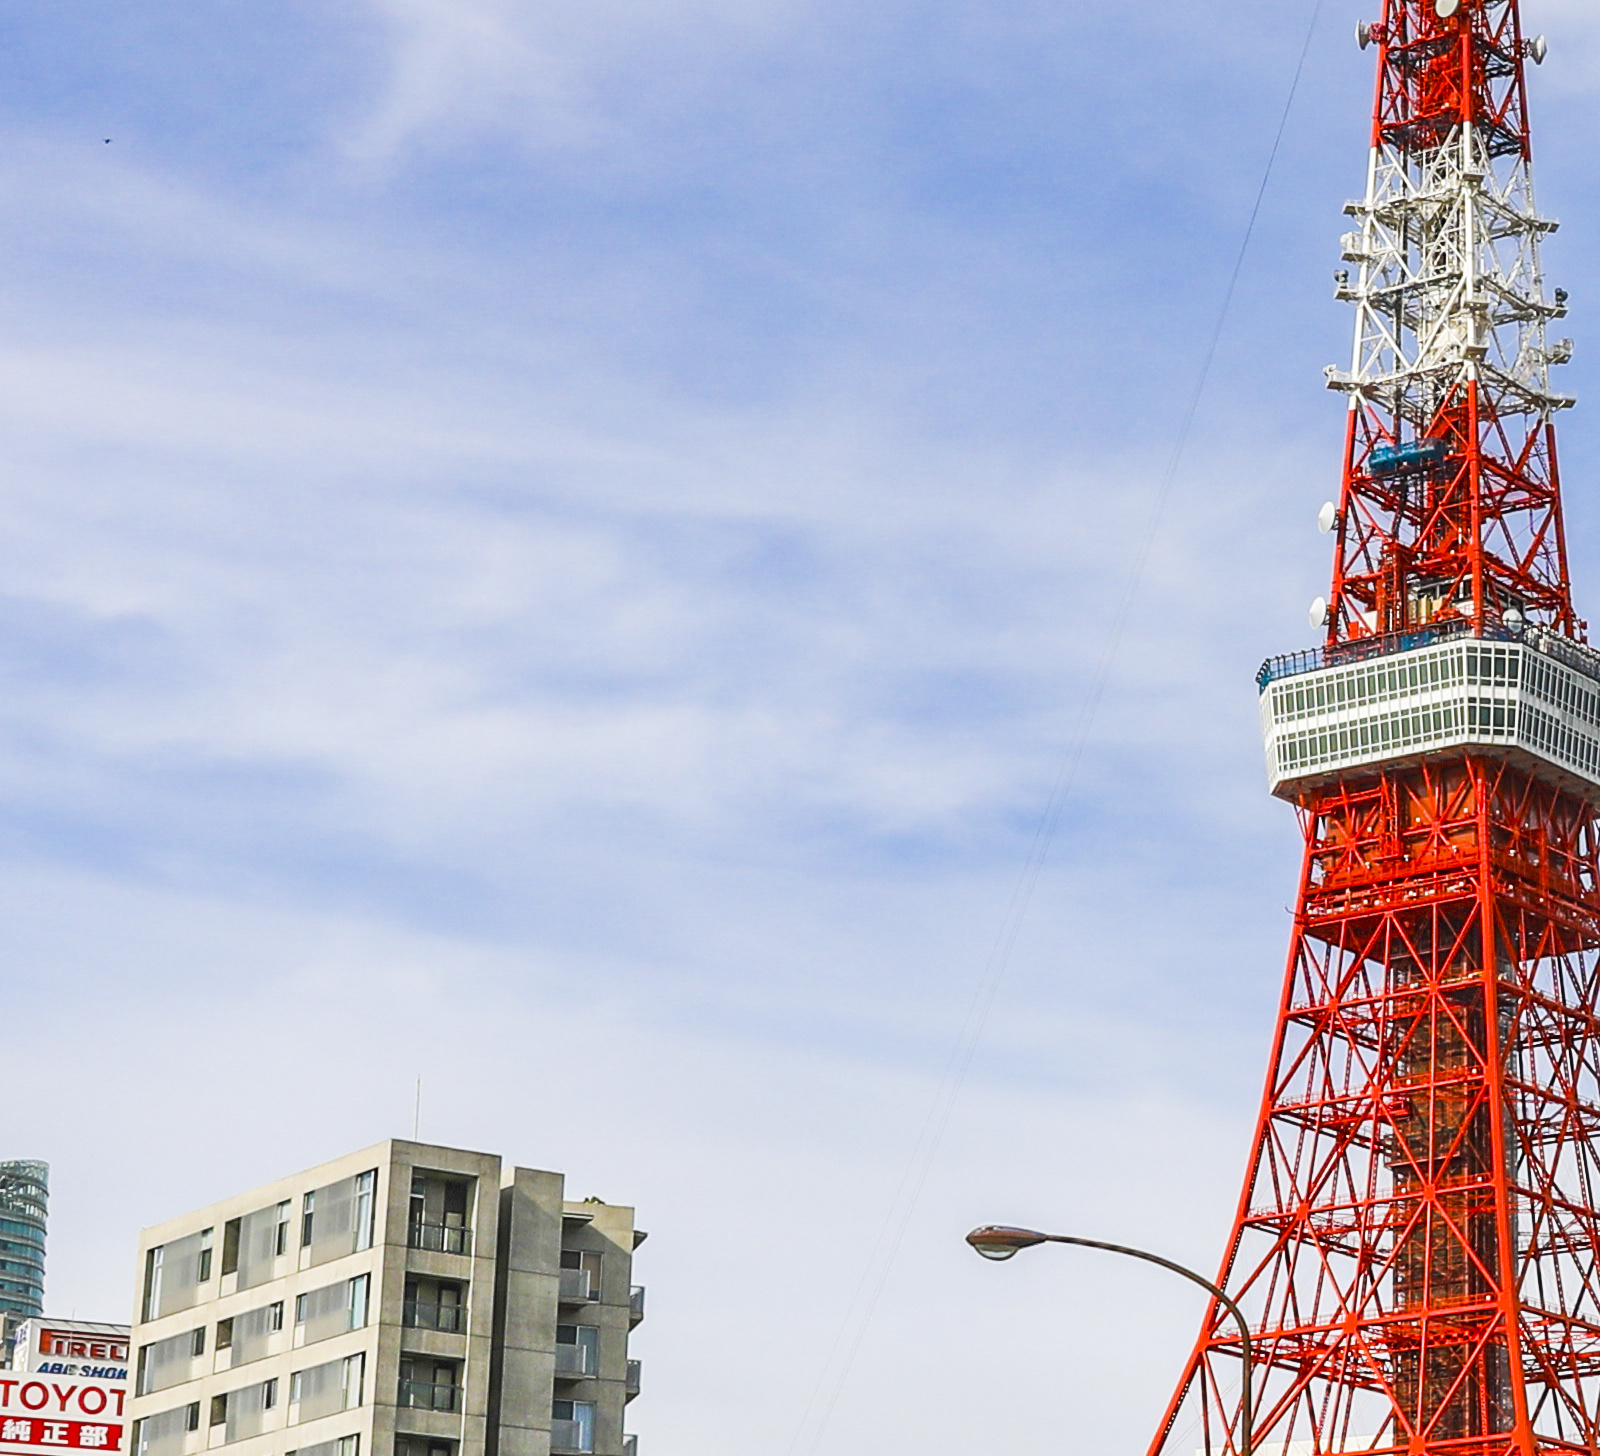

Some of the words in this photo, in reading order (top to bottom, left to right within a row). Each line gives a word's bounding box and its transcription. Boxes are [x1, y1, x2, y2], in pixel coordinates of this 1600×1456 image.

[40, 1328, 130, 1361] PIREL
[1, 1418, 122, 1448] 純正部
